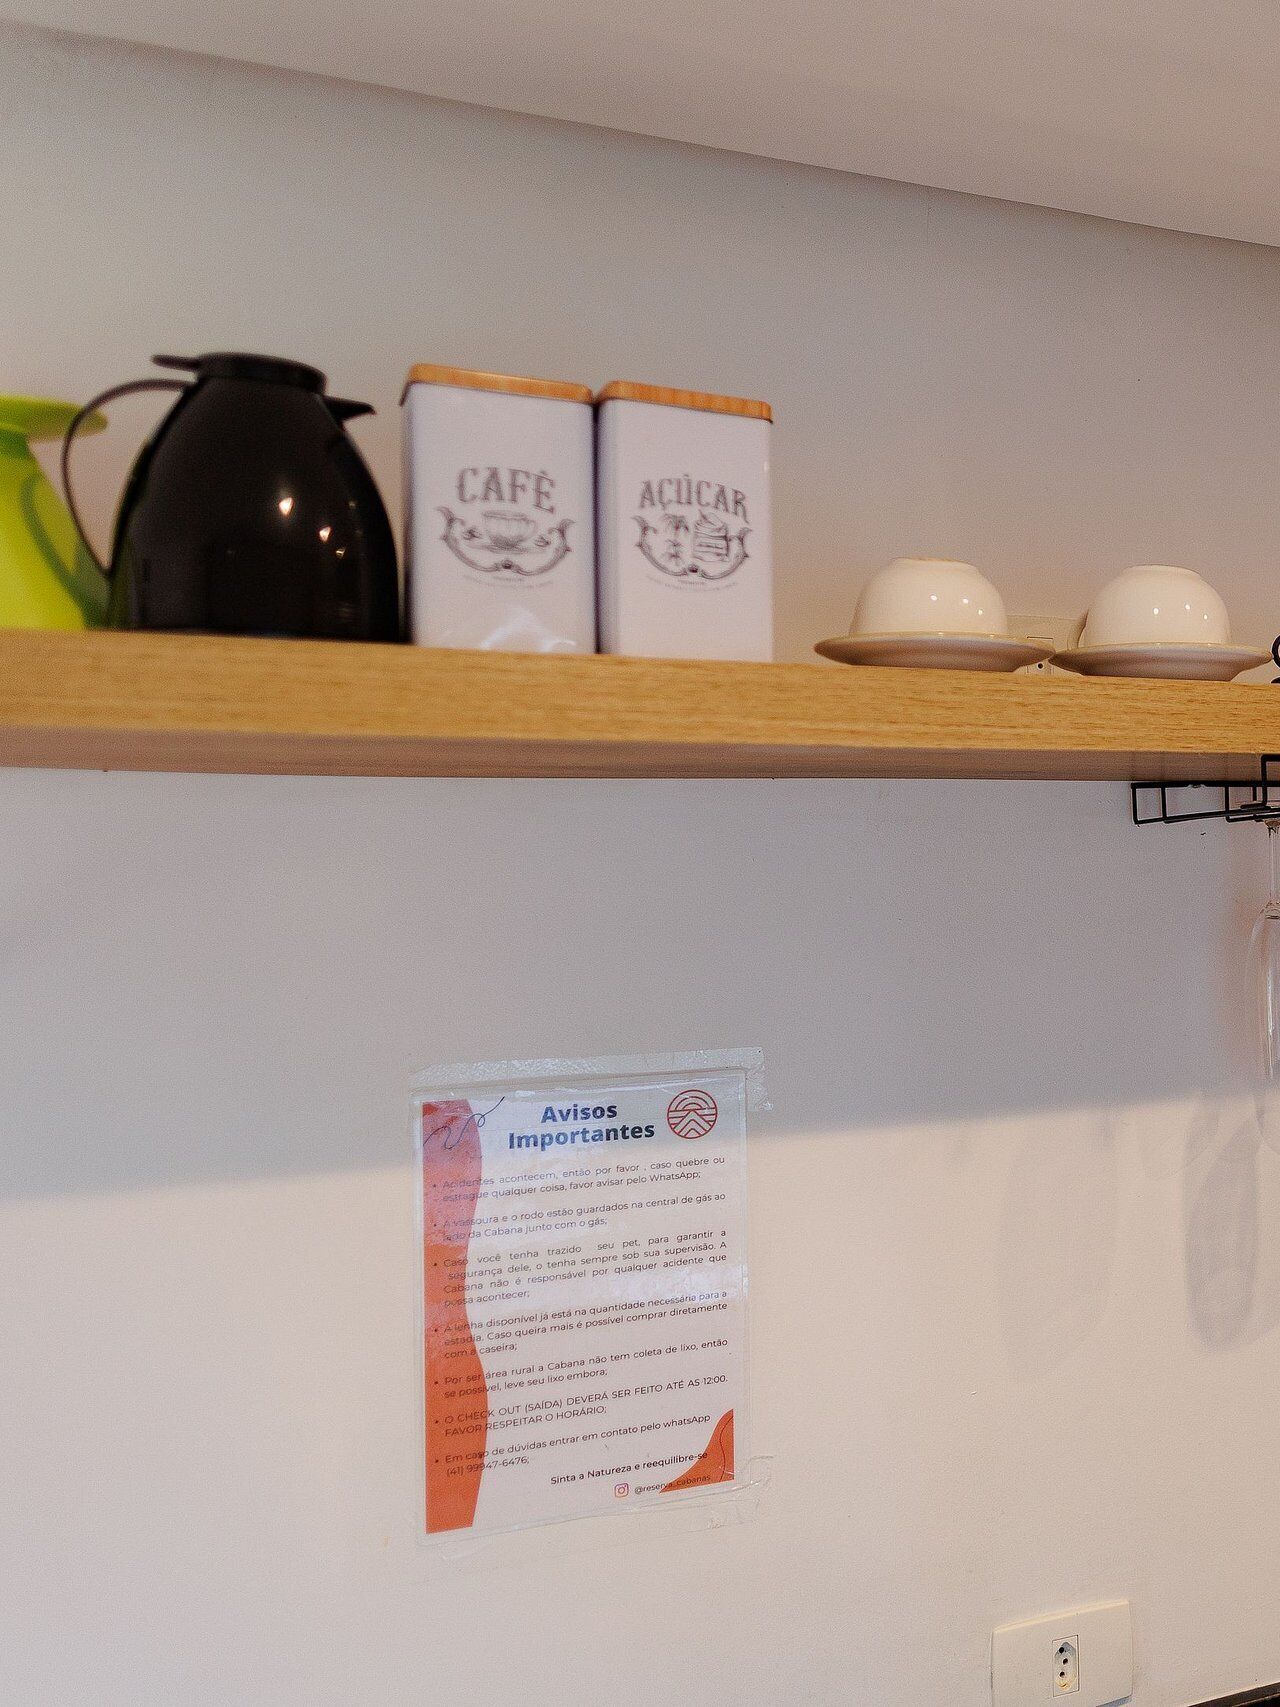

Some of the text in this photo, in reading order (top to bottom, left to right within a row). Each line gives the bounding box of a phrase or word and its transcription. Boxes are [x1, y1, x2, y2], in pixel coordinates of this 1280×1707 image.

[457, 467, 555, 514] CAFÉ
[639, 473, 750, 524] AÇÚCAR
[541, 1103, 617, 1123] Avisos
[509, 1124, 655, 1151] Importantes
[443, 1178, 494, 1190] Acidentes
[500, 1172, 558, 1184] acontecem,
[562, 1168, 591, 1178] então
[596, 1167, 611, 1178] por
[616, 1164, 639, 1173] favor
[650, 1162, 672, 1170] caso
[676, 1157, 709, 1168] quebre
[491, 1185, 536, 1198] qualquer
[540, 1183, 567, 1193] coisa,
[569, 1181, 593, 1190] favor
[596, 1178, 623, 1187] avisar
[626, 1175, 647, 1185] pelo
[452, 1216, 498, 1226] vassoura
[520, 1210, 544, 1220] rodo
[546, 1208, 573, 1217] estão
[577, 1201, 629, 1216] guardados
[631, 1201, 643, 1209] na
[646, 1197, 678, 1207] central
[681, 1195, 693, 1204] de
[695, 1192, 712, 1205] gás
[468, 1229, 481, 1238] da
[484, 1226, 522, 1237] Cabana
[525, 1223, 552, 1235] junto
[443, 1259, 468, 1267] Caso
[476, 1254, 500, 1263] você
[509, 1251, 538, 1260] tenha
[547, 1245, 582, 1256] trazido
[598, 1242, 614, 1250] seu
[622, 1239, 640, 1249] pet,
[648, 1236, 669, 1246] para
[676, 1231, 714, 1243] garantir
[448, 1269, 502, 1281] segurança
[507, 1263, 531, 1273] dele,
[547, 1259, 576, 1269] tenha
[581, 1254, 618, 1265] sempre
[622, 1251, 639, 1260] sob
[644, 1250, 660, 1258] sua
[664, 1243, 716, 1256] supervisão.
[719, 1241, 727, 1249] A
[444, 1254, 727, 1294] Cabana não é responsável por qualquer acidente que
[454, 1322, 483, 1331] lenha
[486, 1313, 537, 1328] disponível
[539, 1312, 549, 1323] já
[551, 1308, 572, 1318] está
[574, 1308, 587, 1316] na
[590, 1301, 645, 1315] quantidade
[648, 1294, 696, 1307] necessária
[698, 1292, 719, 1302] para
[477, 1291, 530, 1303] acontecer;
[444, 1303, 727, 1346] estadia. Caso queira mais é possível comprar diretamente
[444, 1350, 468, 1359] com
[479, 1343, 517, 1354] caseira;
[444, 1376, 463, 1385] Por
[486, 1370, 507, 1379] área
[511, 1365, 535, 1374] rural
[547, 1360, 585, 1370] Cabana
[588, 1356, 607, 1365] não
[610, 1353, 630, 1361] tem
[633, 1349, 662, 1359] coleta
[665, 1346, 677, 1354] de
[680, 1343, 698, 1351] lixo,
[701, 1339, 727, 1348] então
[458, 1384, 501, 1397] possível,
[504, 1381, 524, 1390] leve
[527, 1378, 544, 1386] seu
[547, 1374, 564, 1383] lixo
[567, 1368, 608, 1380] embora;
[444, 1375, 728, 1424] O CHECK OUT (SAÍDA) DEVERÁ SER FEITO ATÉ AS 12:00.
[445, 1406, 607, 1437] FAVOR RESPEITAR O HORÁRIO;
[445, 1414, 710, 1463] Em caso de dúvidas entrar em contato pelo whatsApp
[446, 1466, 463, 1476] (41)
[551, 1475, 575, 1484] Sinta
[587, 1465, 632, 1478] Natureza
[642, 1452, 708, 1468] reequilibre-se
